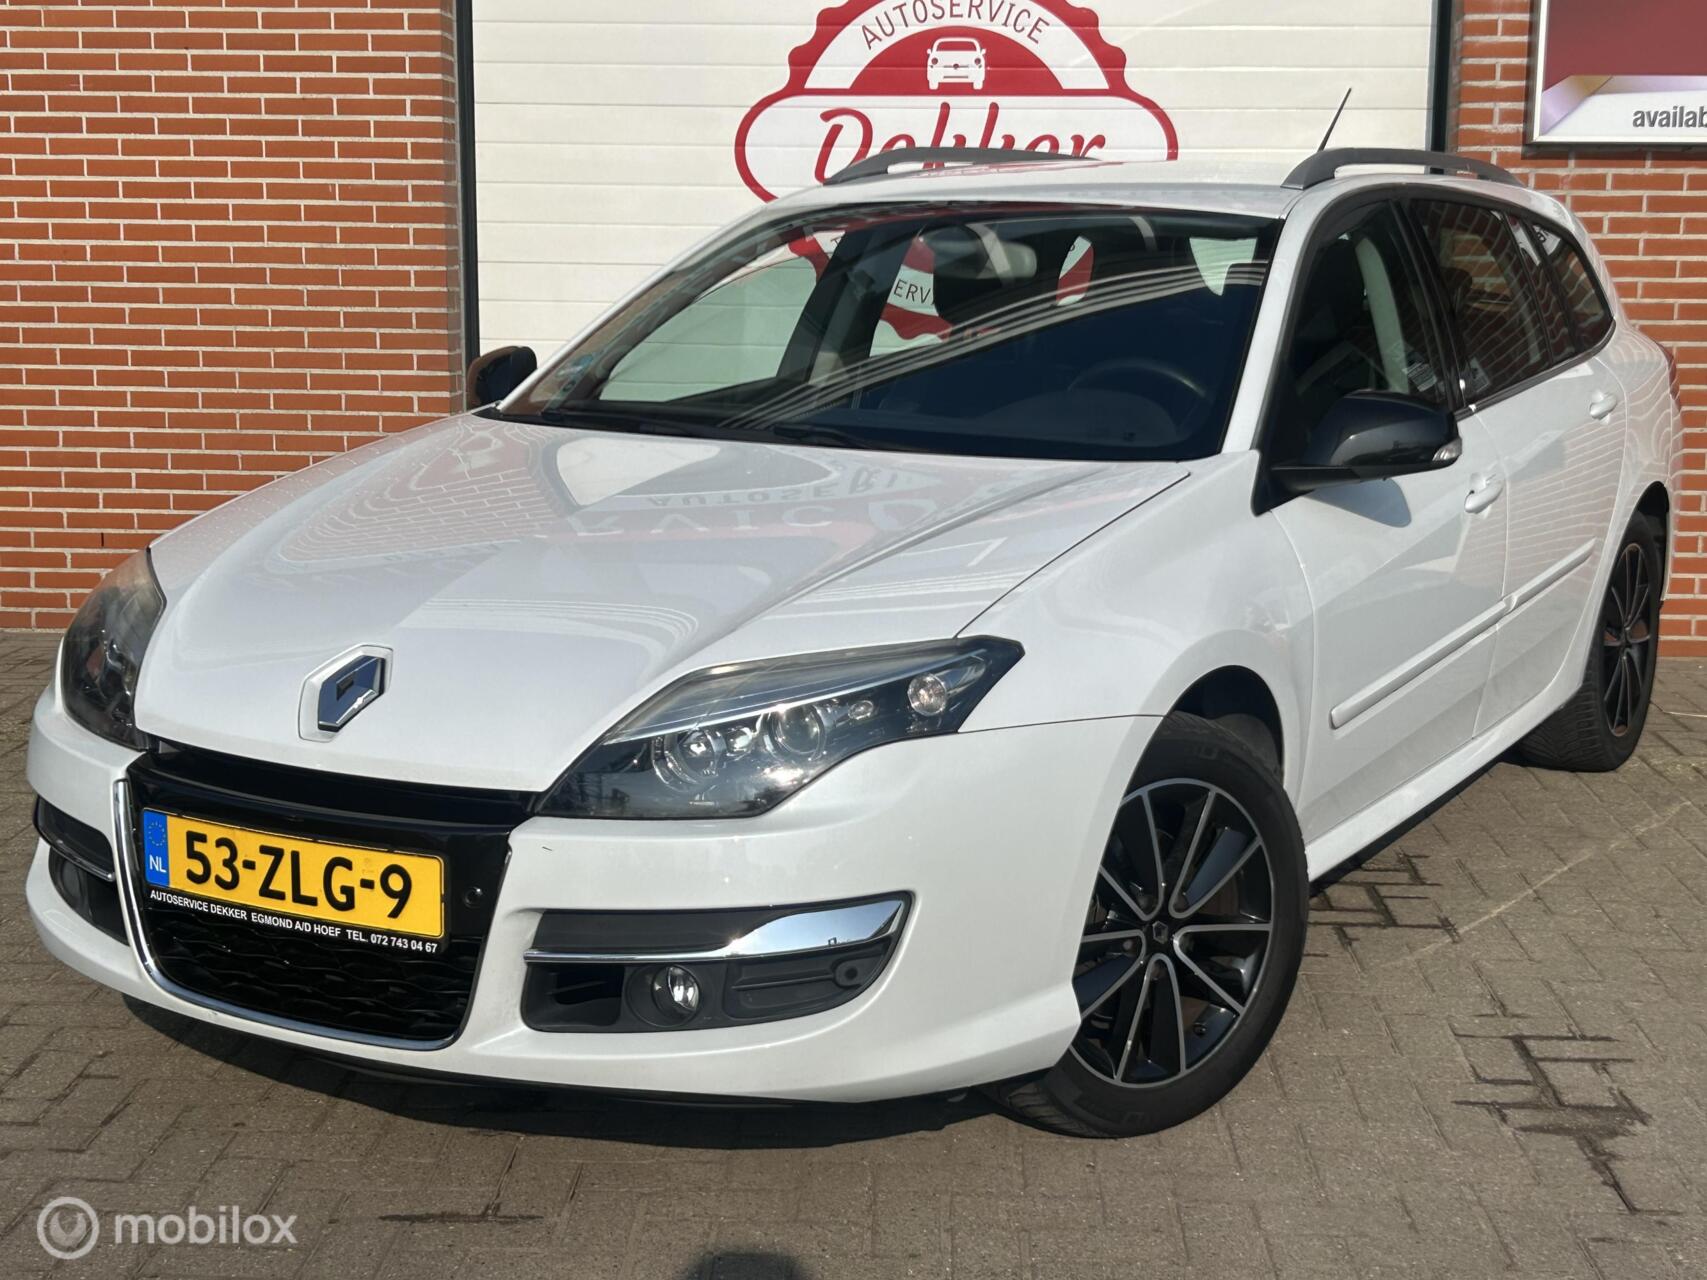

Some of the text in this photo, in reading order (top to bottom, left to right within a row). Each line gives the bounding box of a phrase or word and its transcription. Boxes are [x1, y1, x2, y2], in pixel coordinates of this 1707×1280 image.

[861, 0, 1050, 50] AUTOSERVICE
[149, 854, 167, 874] NL
[186, 830, 412, 919] 53-ZLG-9
[150, 889, 209, 912] AUTOSERVICE
[210, 903, 248, 920] DEKKER
[251, 912, 293, 929] EGMOND
[313, 923, 342, 937] HOEF
[345, 929, 369, 943] TEL.
[370, 933, 389, 946] 072
[390, 936, 409, 949] 743
[410, 940, 423, 951] 04
[425, 942, 438, 953] 67
